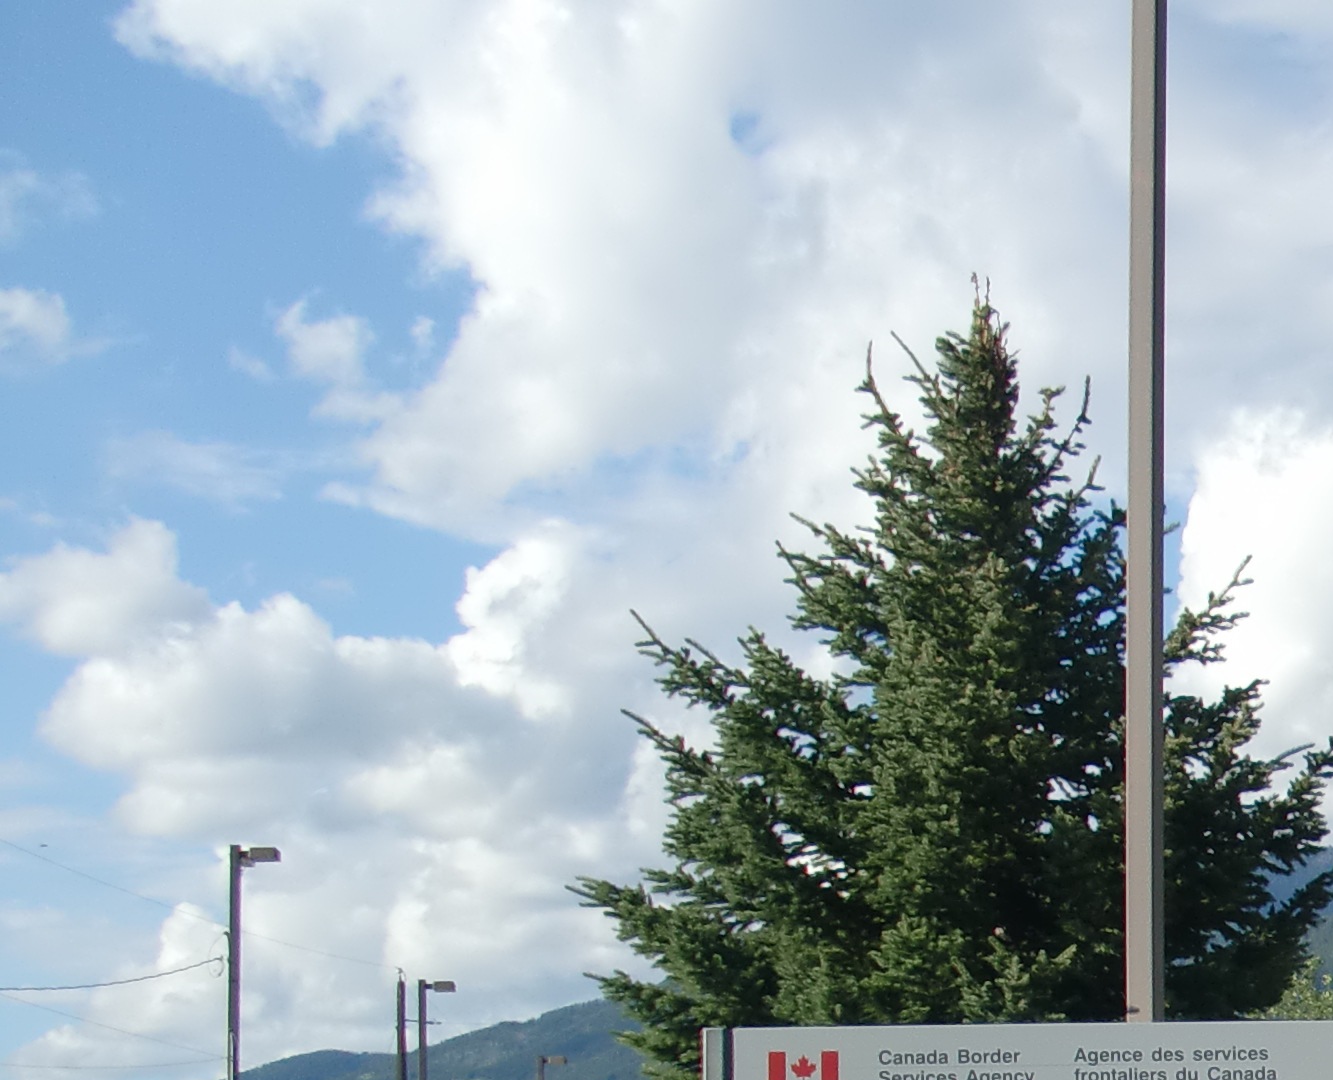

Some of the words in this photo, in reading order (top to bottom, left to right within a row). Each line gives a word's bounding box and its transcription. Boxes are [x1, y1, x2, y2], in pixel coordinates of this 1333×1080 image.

[878, 1049, 949, 1066] Canada
[957, 1048, 1021, 1064] Border
[1074, 1047, 1143, 1066] Agence
[1151, 1047, 1185, 1062] des
[1192, 1045, 1269, 1062] services
